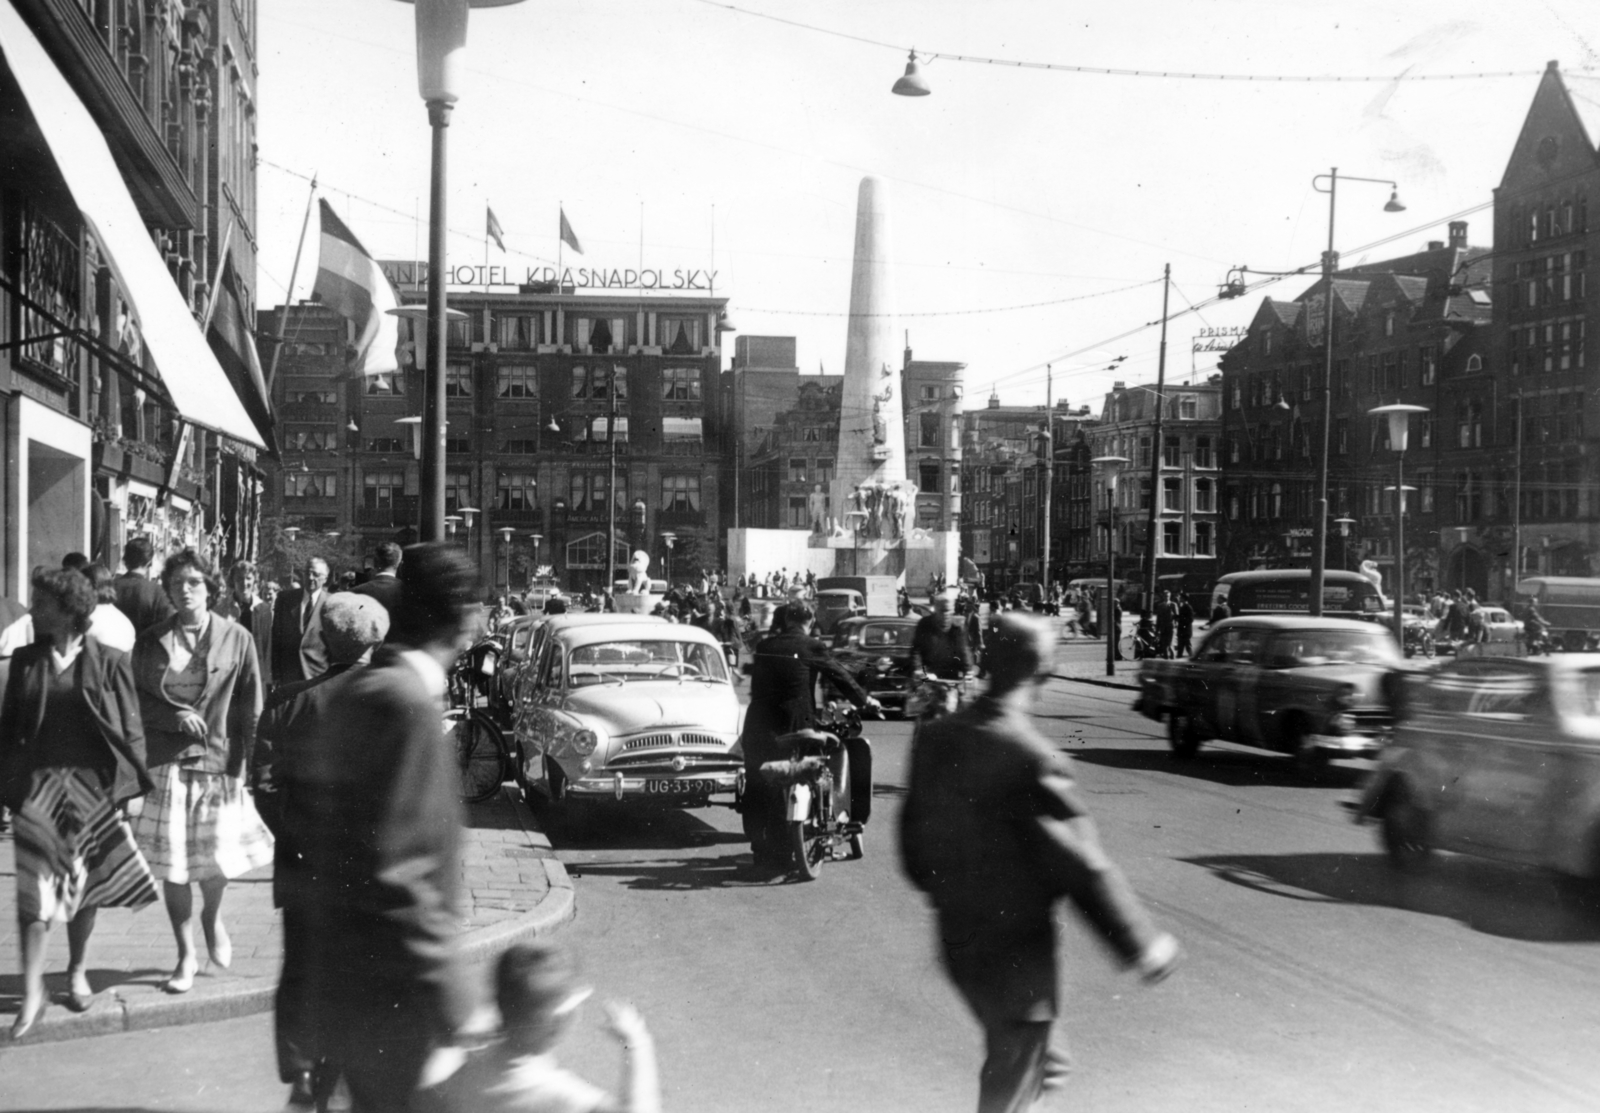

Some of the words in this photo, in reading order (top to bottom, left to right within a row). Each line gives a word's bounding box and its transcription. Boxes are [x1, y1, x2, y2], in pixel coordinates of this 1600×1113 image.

[446, 265, 515, 285] HOTEL
[526, 266, 718, 289] KRASNAPOLSKY
[1199, 326, 1248, 337] PRISMA
